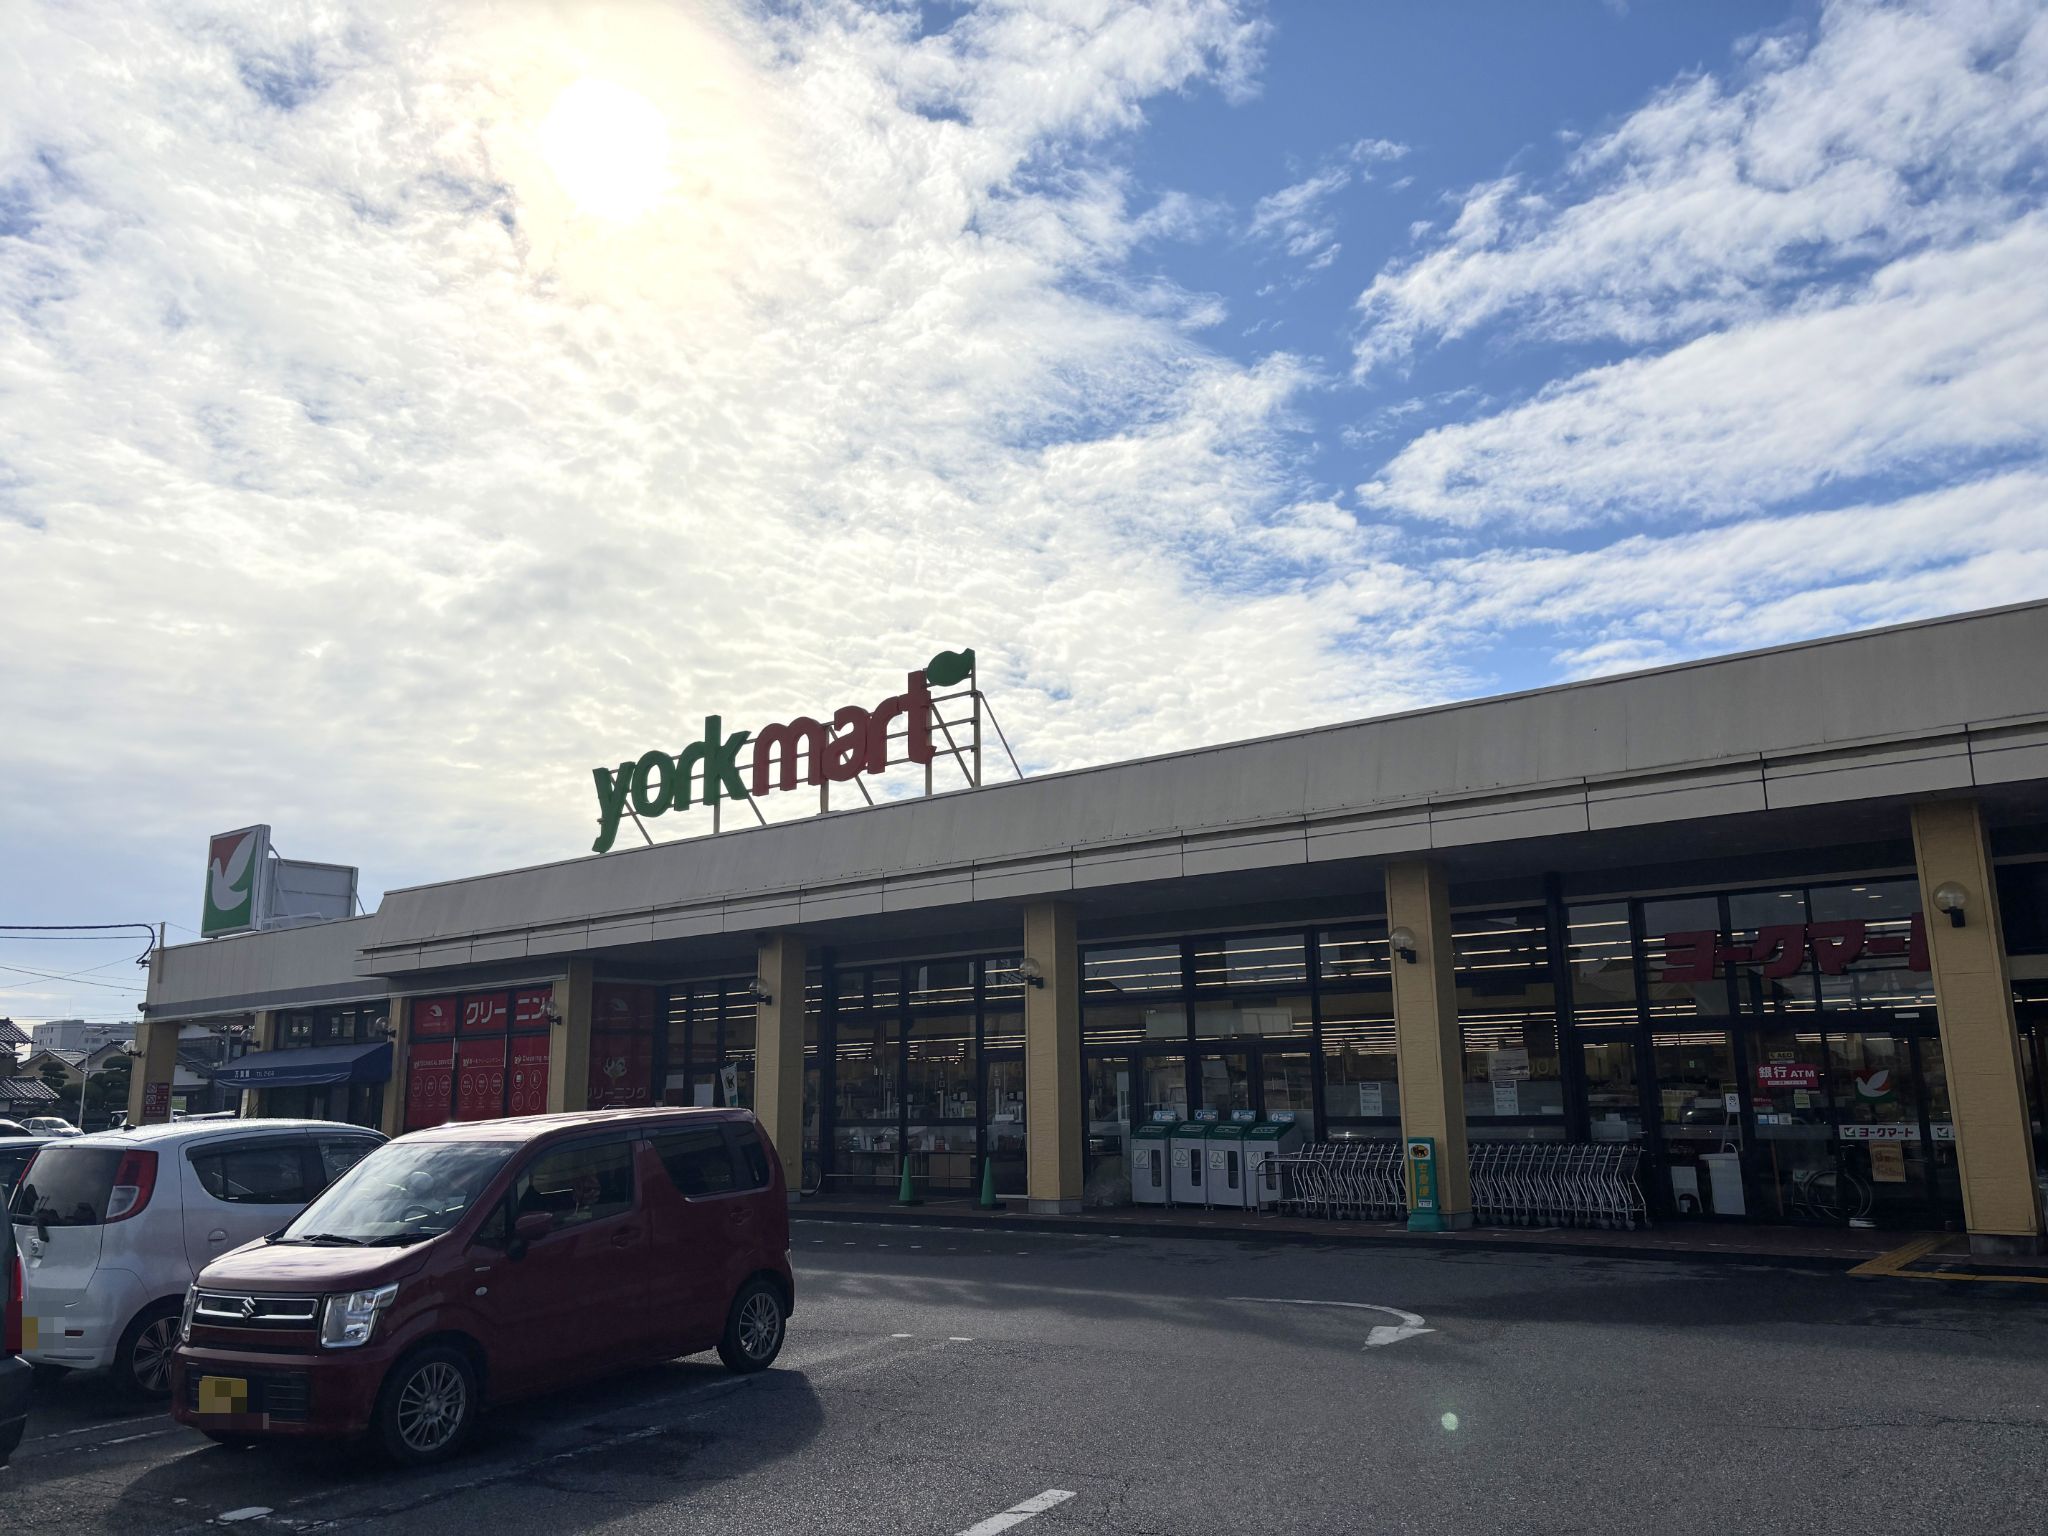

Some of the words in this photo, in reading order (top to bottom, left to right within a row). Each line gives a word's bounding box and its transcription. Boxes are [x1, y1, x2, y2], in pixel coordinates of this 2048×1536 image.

[1758, 1066, 1787, 1078] 銀行
[1790, 1070, 1815, 1078] ATM
[1859, 1127, 1914, 1137] ヨークマート
